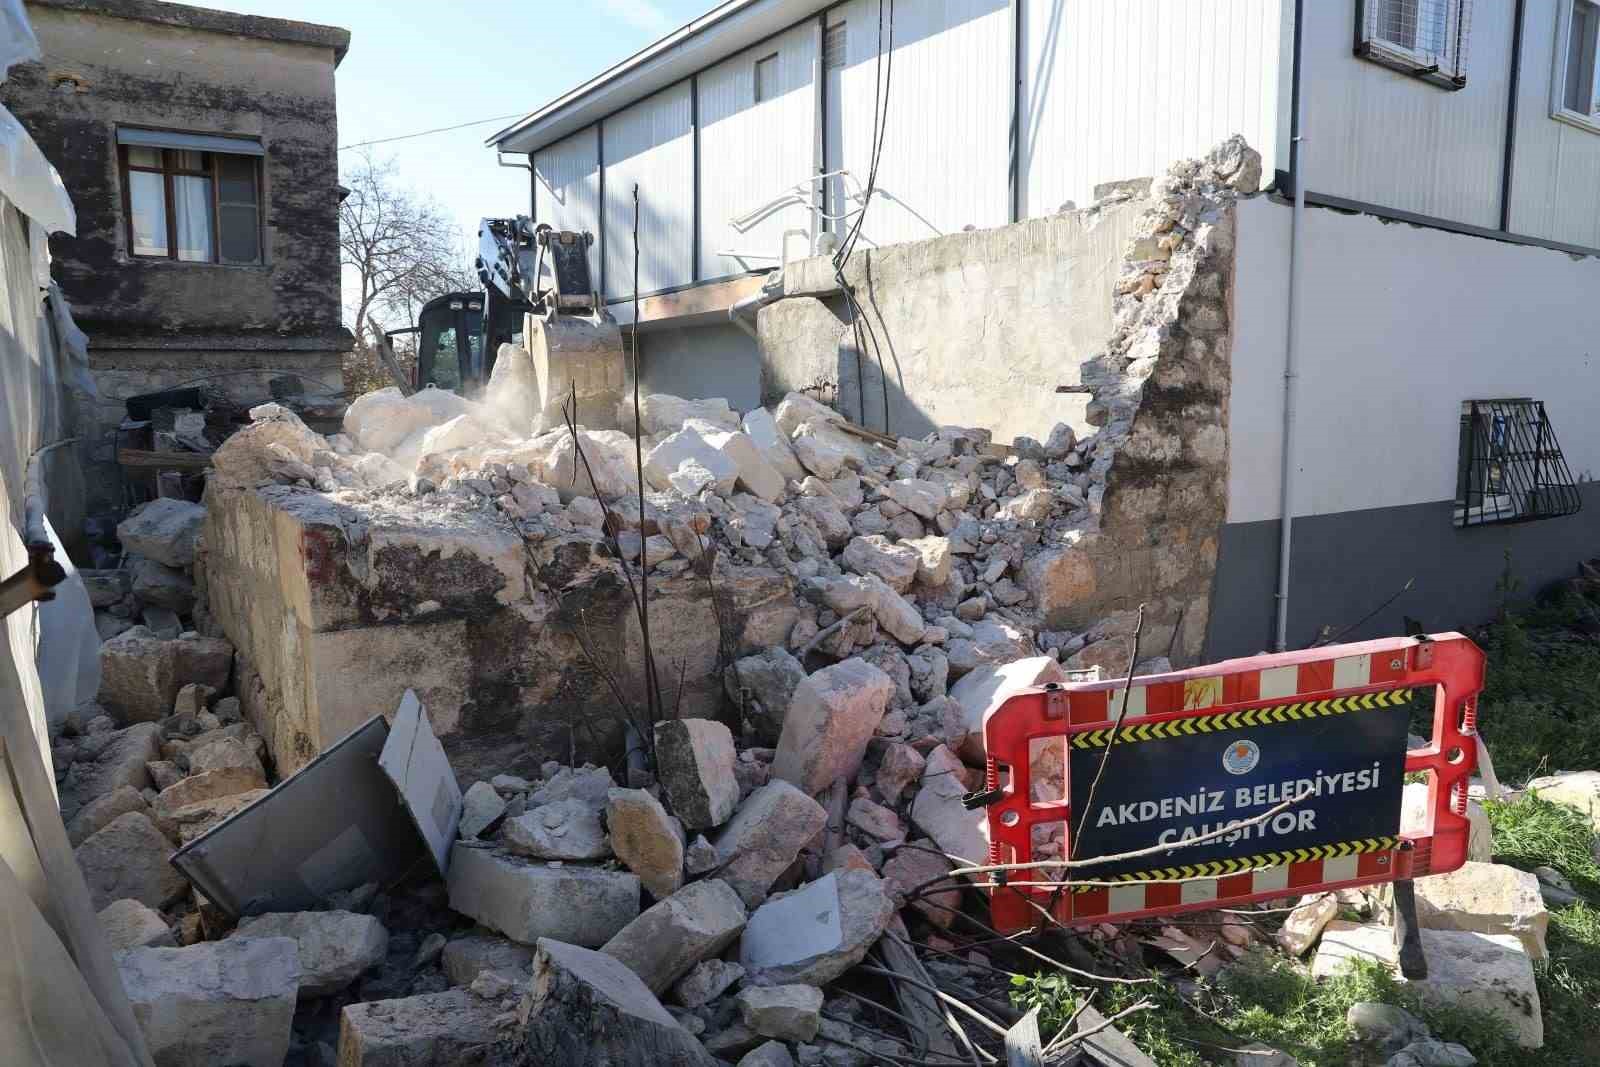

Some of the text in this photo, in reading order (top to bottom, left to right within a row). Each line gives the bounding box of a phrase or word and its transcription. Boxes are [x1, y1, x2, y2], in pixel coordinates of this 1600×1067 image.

[1096, 762, 1380, 828] AKDENİZ BELEDİYESİ
[1158, 809, 1316, 856] ÇALIŞIYOR
